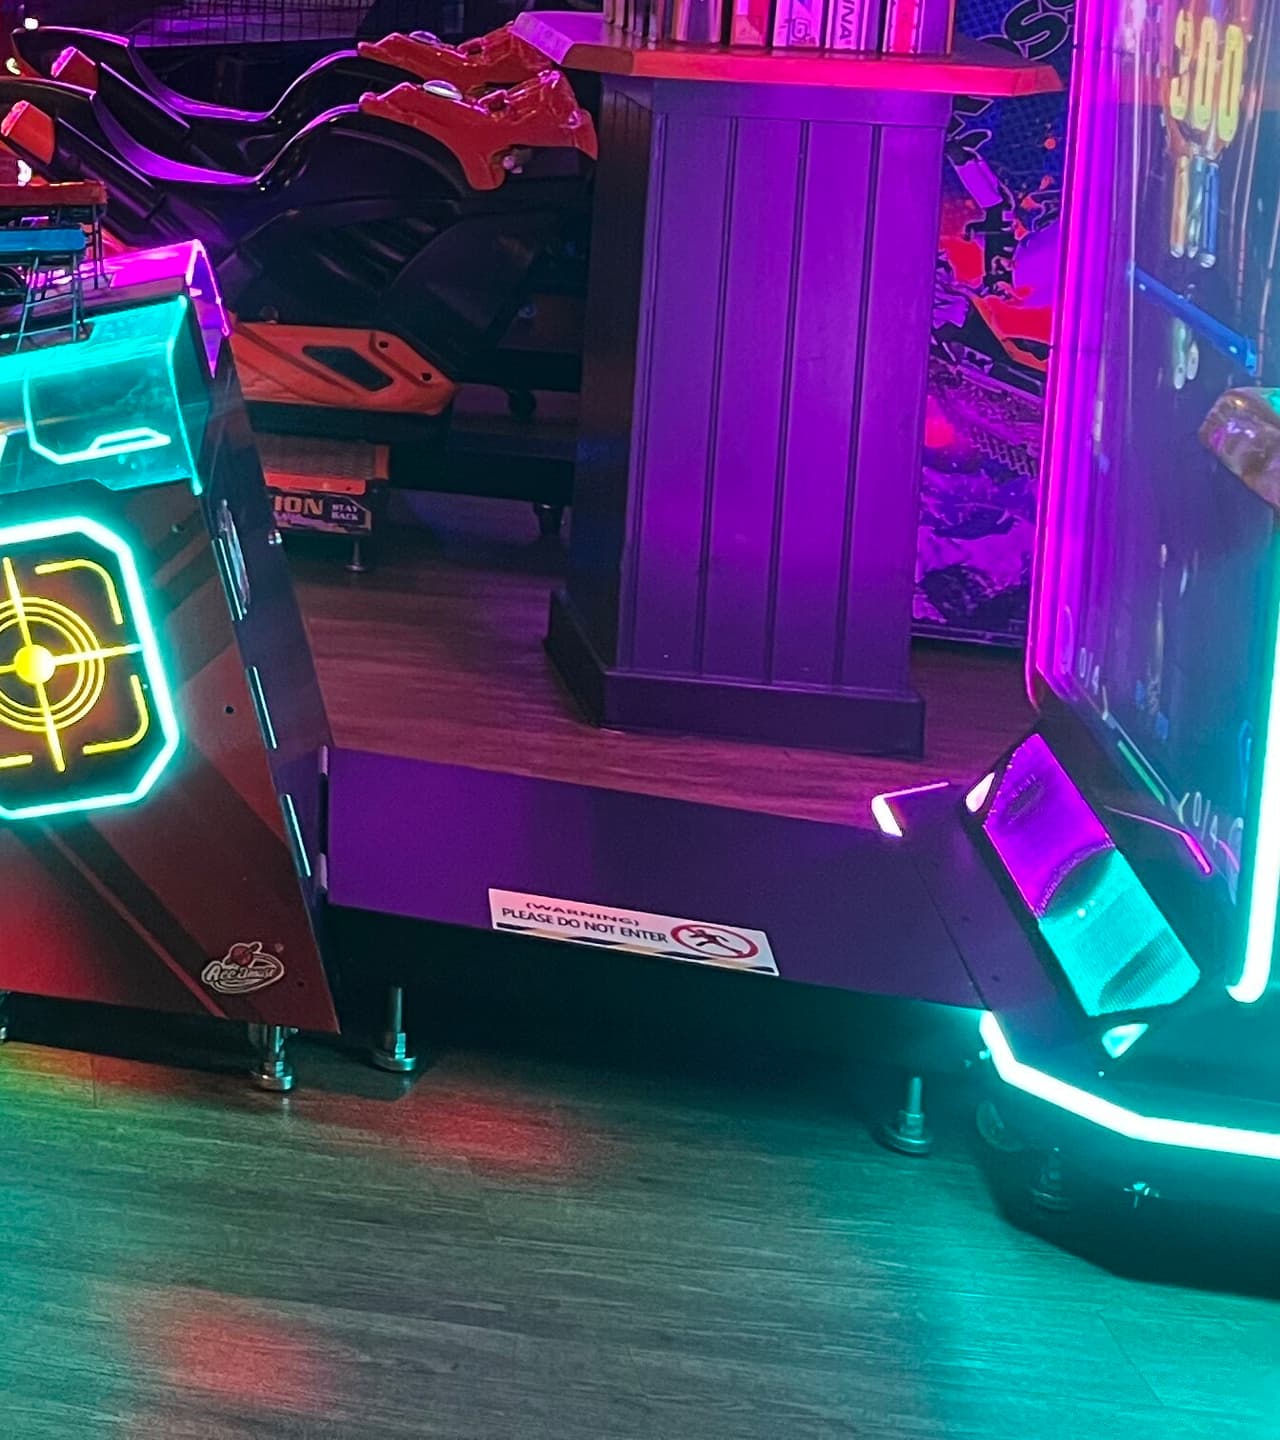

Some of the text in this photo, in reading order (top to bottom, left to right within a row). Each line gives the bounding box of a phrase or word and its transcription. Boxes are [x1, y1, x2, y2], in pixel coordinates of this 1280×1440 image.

[1170, 9, 1243, 142] 300
[275, 496, 323, 515] ION
[502, 907, 669, 944] PLEASE DO NOT ENTER
[526, 902, 640, 926] (WARNING)
